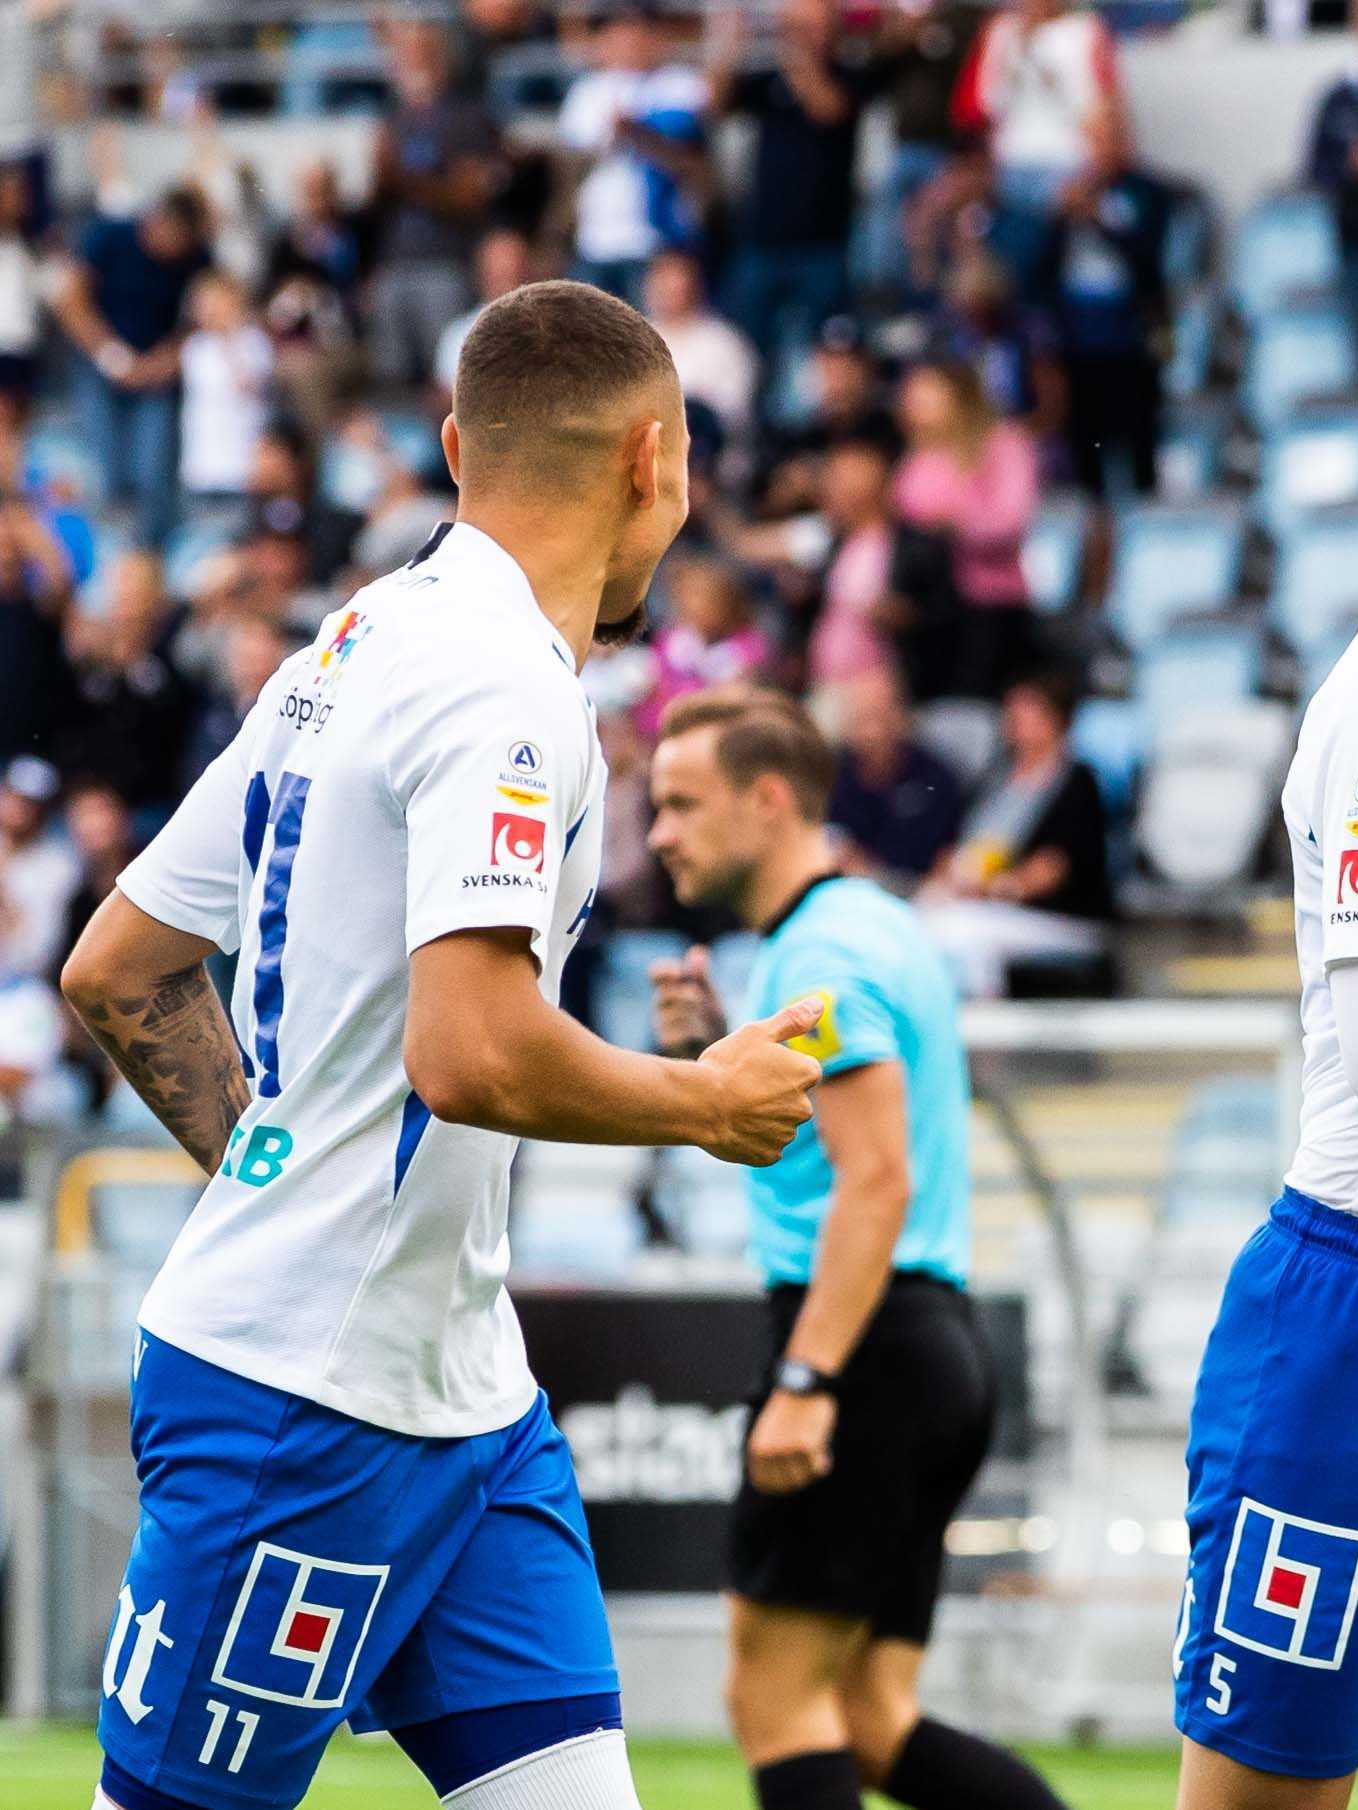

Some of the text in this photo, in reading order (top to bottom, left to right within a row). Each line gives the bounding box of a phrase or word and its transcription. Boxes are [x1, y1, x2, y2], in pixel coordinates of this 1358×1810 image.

[462, 873, 533, 889] SVENSKA
[1206, 1652, 1237, 1716] 5
[198, 1699, 261, 1774] 11
